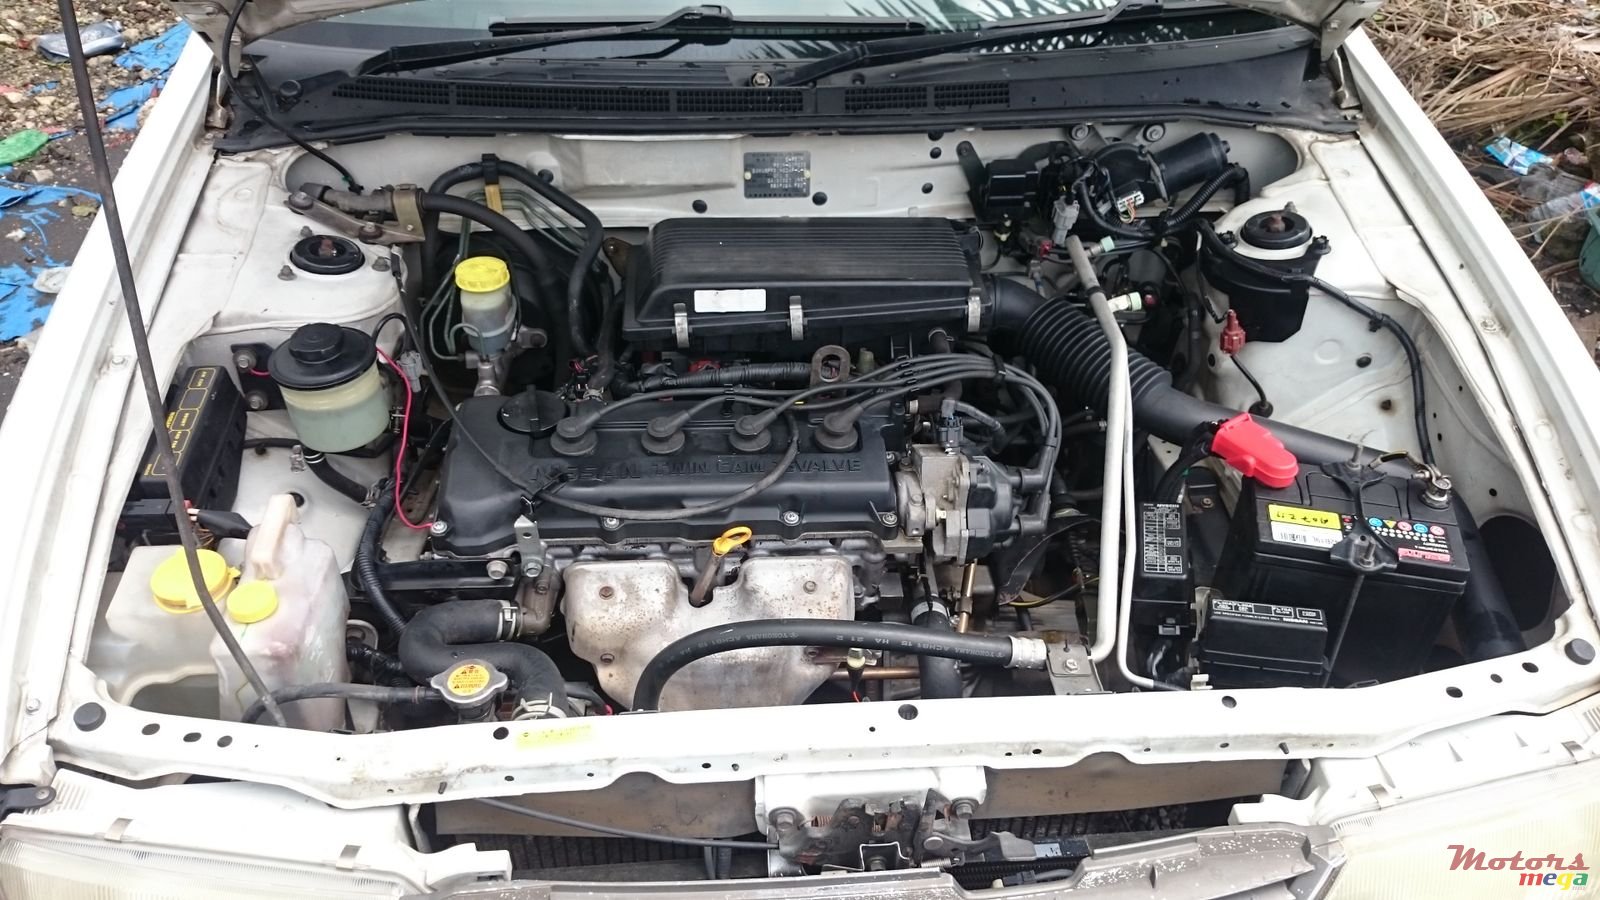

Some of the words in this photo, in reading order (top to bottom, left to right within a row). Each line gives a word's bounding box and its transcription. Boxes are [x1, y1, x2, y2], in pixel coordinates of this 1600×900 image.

[529, 463, 641, 480] NSSAN
[651, 461, 711, 475] TWIN
[954, 647, 995, 658] YOKOHAMA
